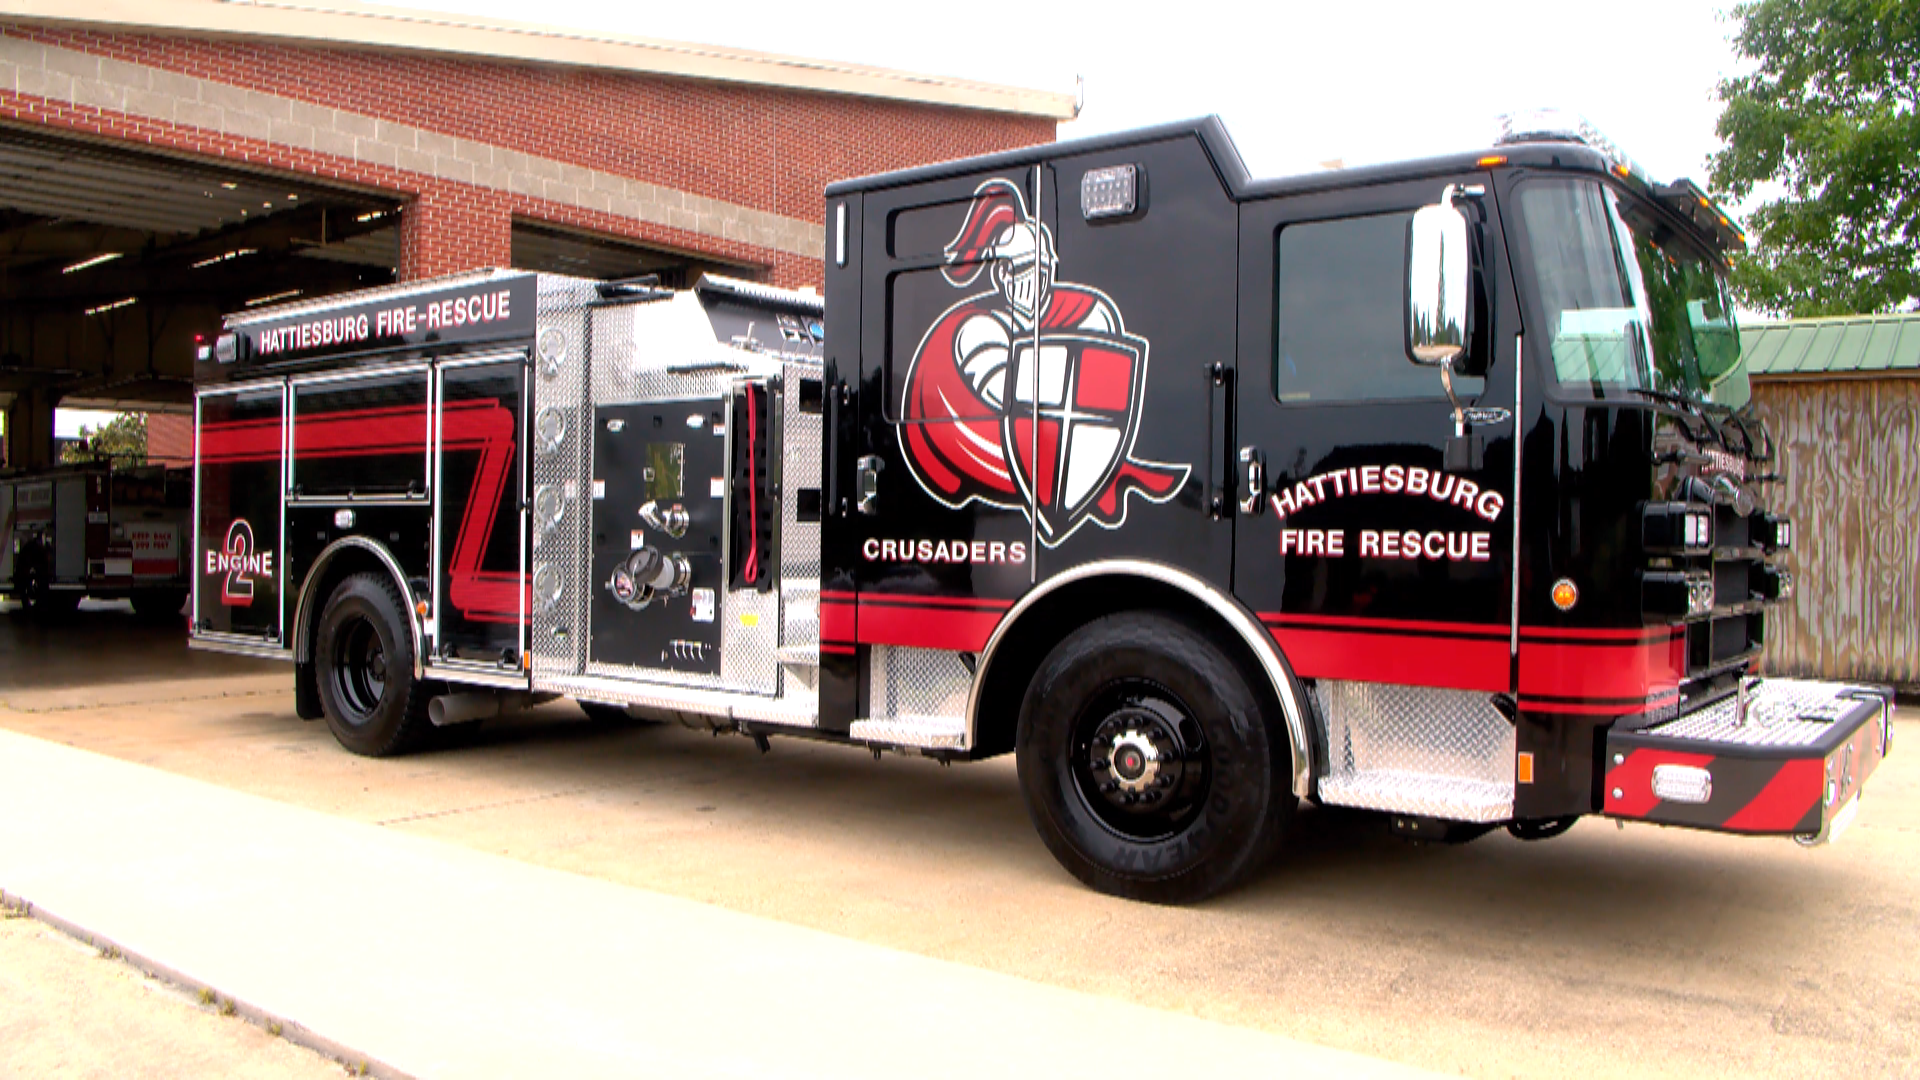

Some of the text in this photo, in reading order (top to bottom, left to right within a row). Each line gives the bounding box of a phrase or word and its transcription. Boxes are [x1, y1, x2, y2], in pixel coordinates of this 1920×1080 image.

[260, 290, 511, 354] HATTIESBURG FIRE-RESCUE
[1271, 464, 1504, 521] HATTIESBURG
[862, 537, 1027, 563] CRUSADERS
[1280, 528, 1491, 561] FIRE RESCUE
[206, 550, 273, 577] ENGINE
